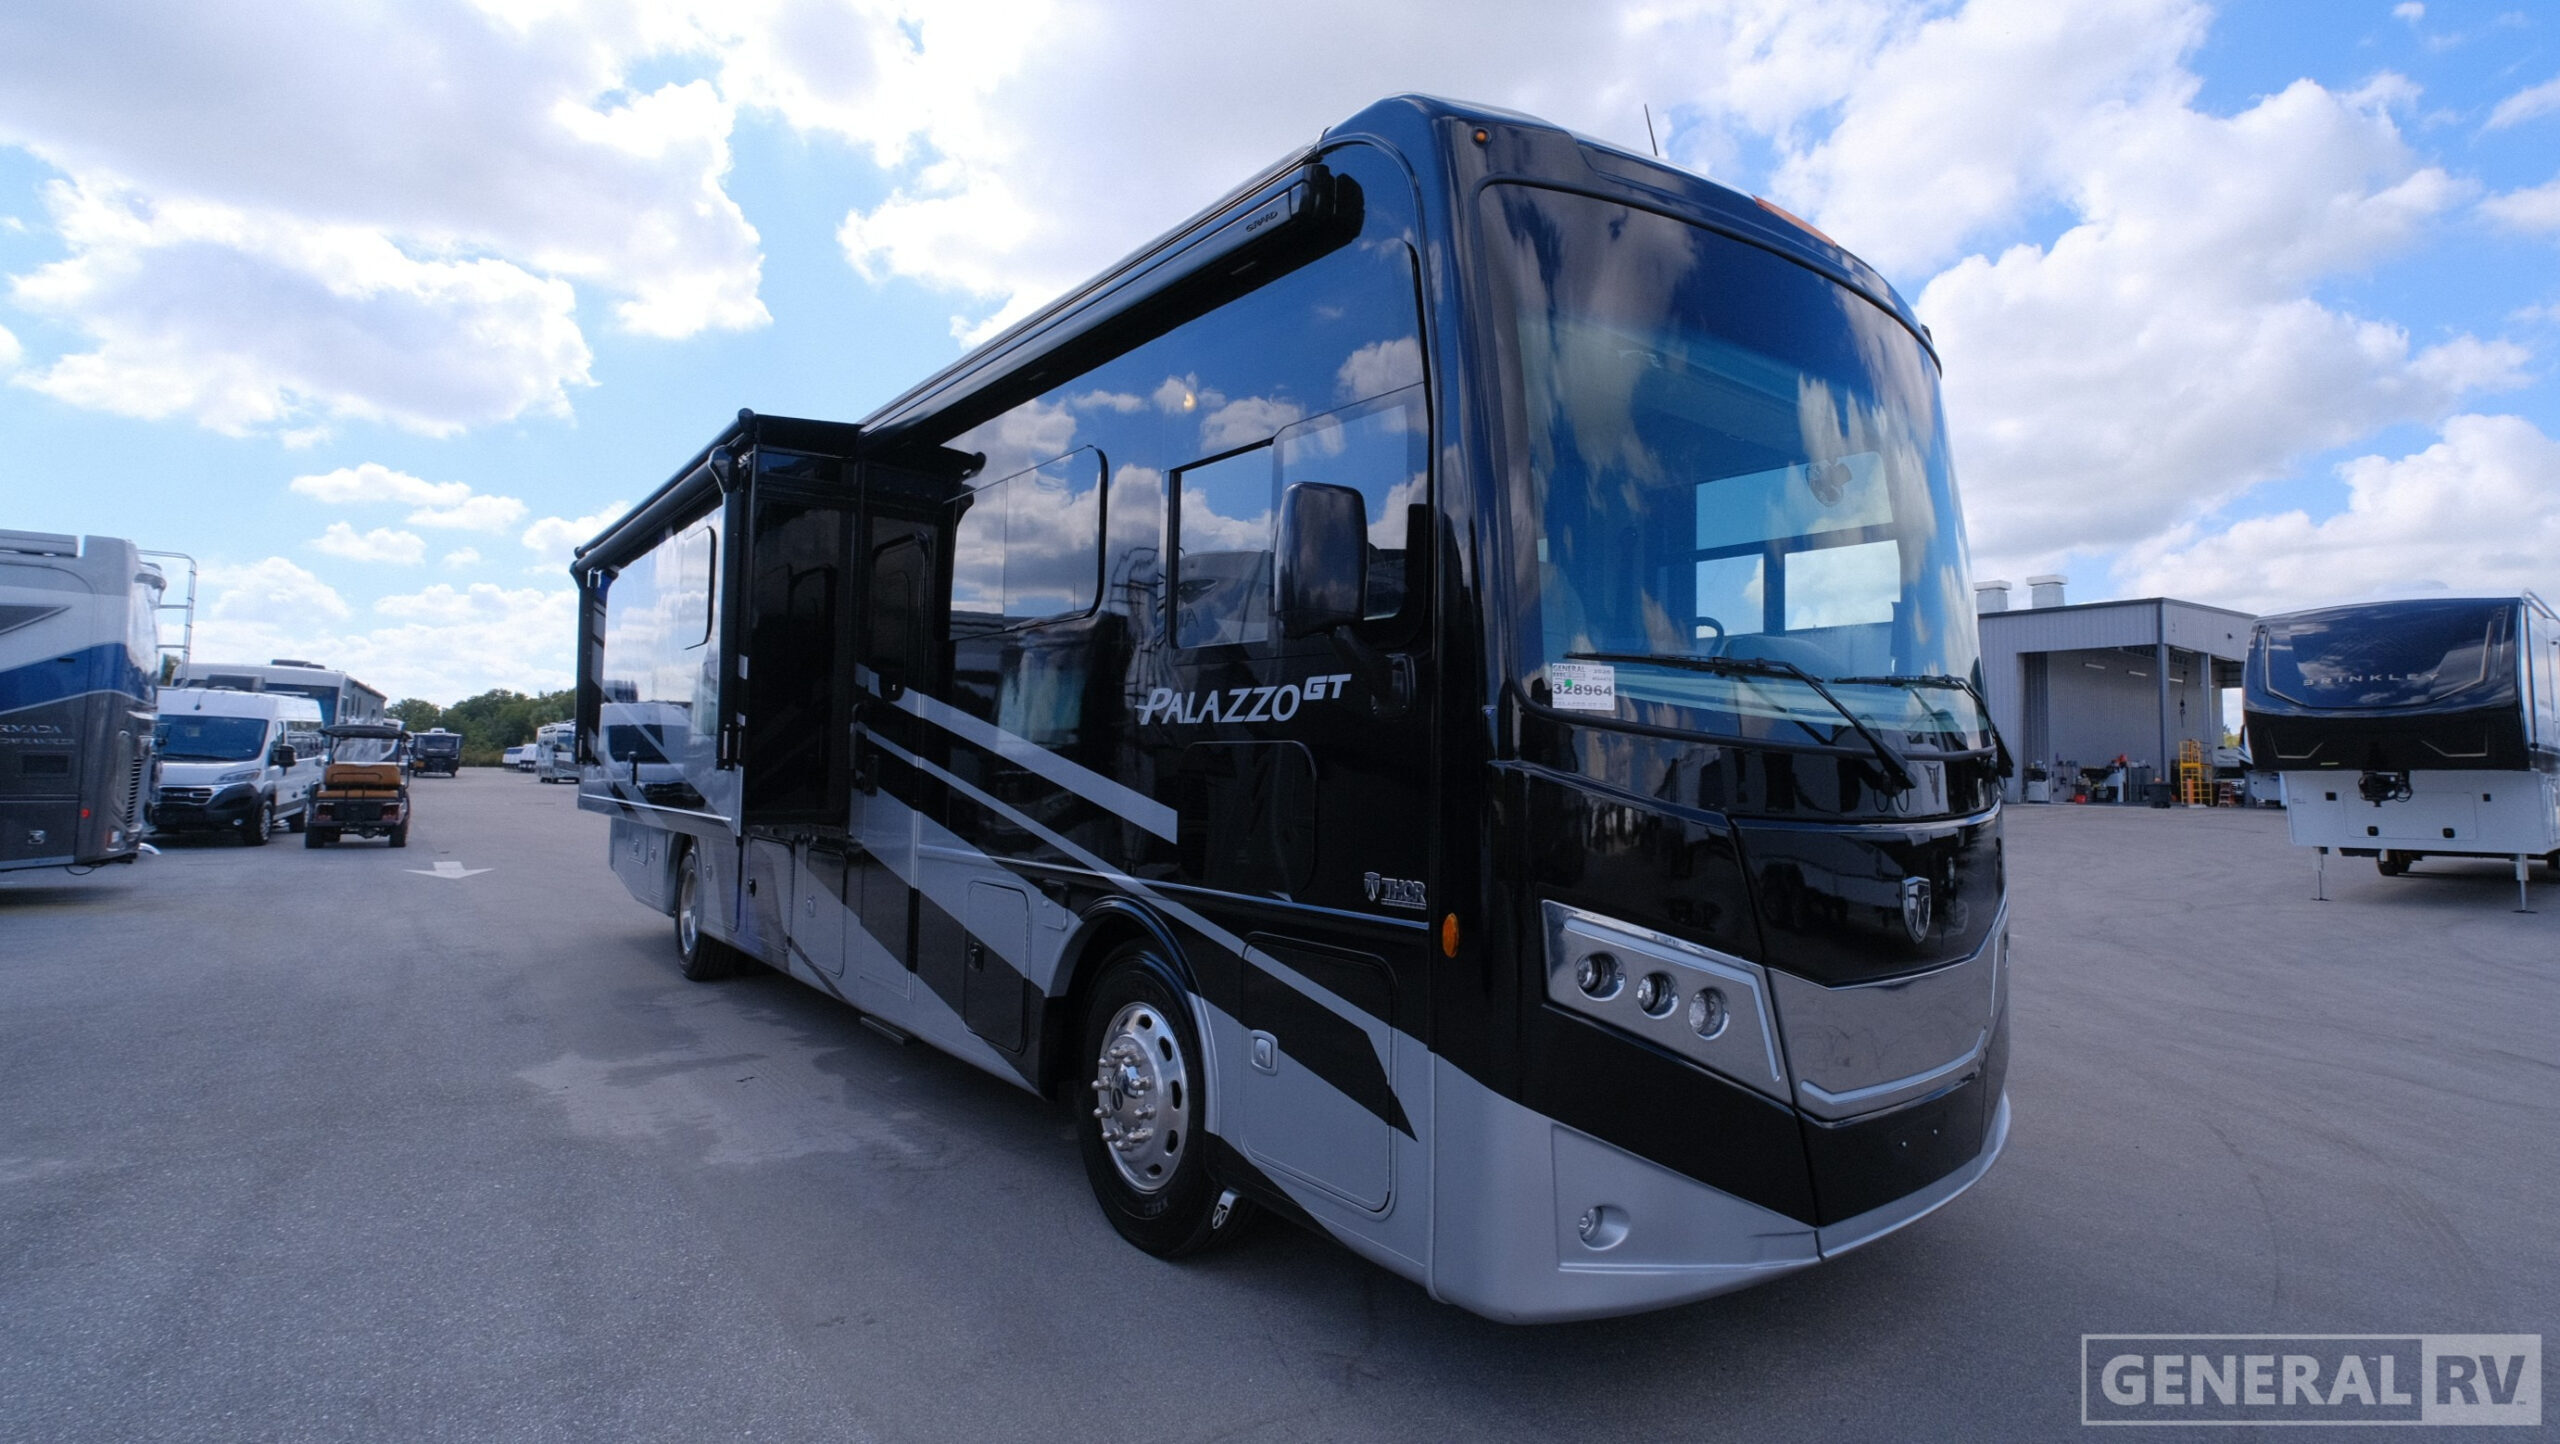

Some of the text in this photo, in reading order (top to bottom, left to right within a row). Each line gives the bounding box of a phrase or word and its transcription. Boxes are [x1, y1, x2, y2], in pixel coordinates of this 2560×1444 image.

[2303, 673, 2440, 686] BRINKLEY
[1553, 683, 1613, 696] 328964
[1134, 674, 1352, 725] PALAZZO GT
[1381, 877, 1426, 903] THOR
